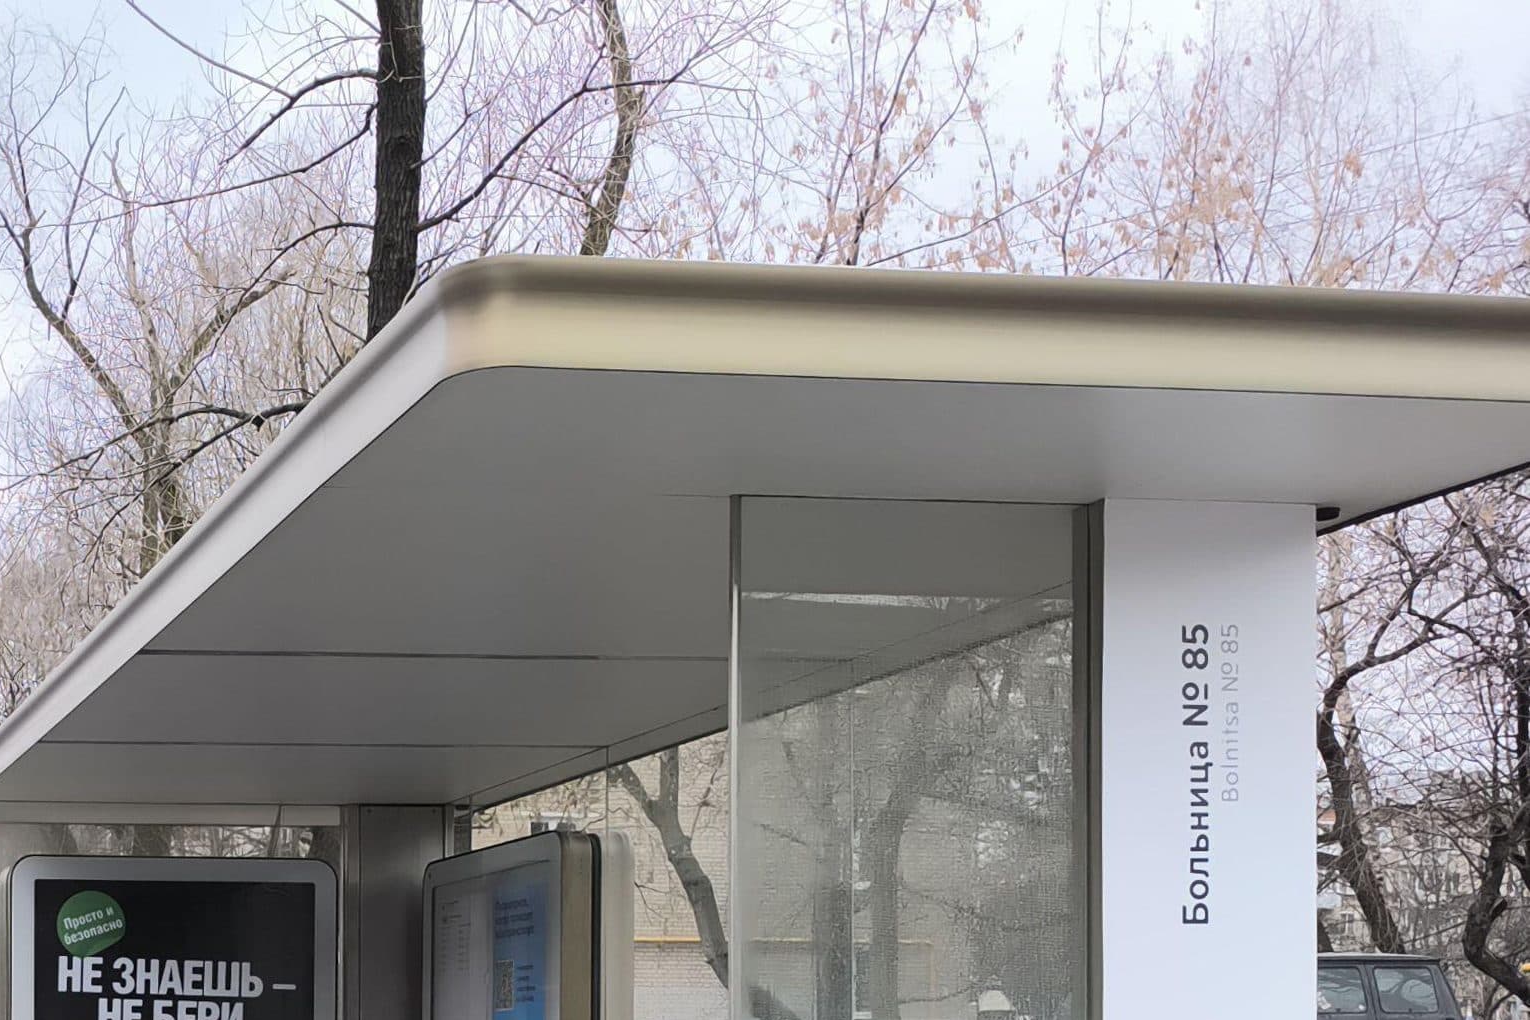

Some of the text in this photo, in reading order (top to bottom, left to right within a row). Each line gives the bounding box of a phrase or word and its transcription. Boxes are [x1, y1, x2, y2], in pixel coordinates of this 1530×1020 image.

[1221, 624, 1239, 654] 85
[1220, 702, 1239, 801] Bolnitsa
[1182, 624, 1213, 924] Больница № 85
[63, 906, 115, 930] Просто и
[64, 919, 123, 945] безопасно
[58, 955, 103, 993] НЕ
[113, 957, 264, 998] ЗНАЕШЬ
